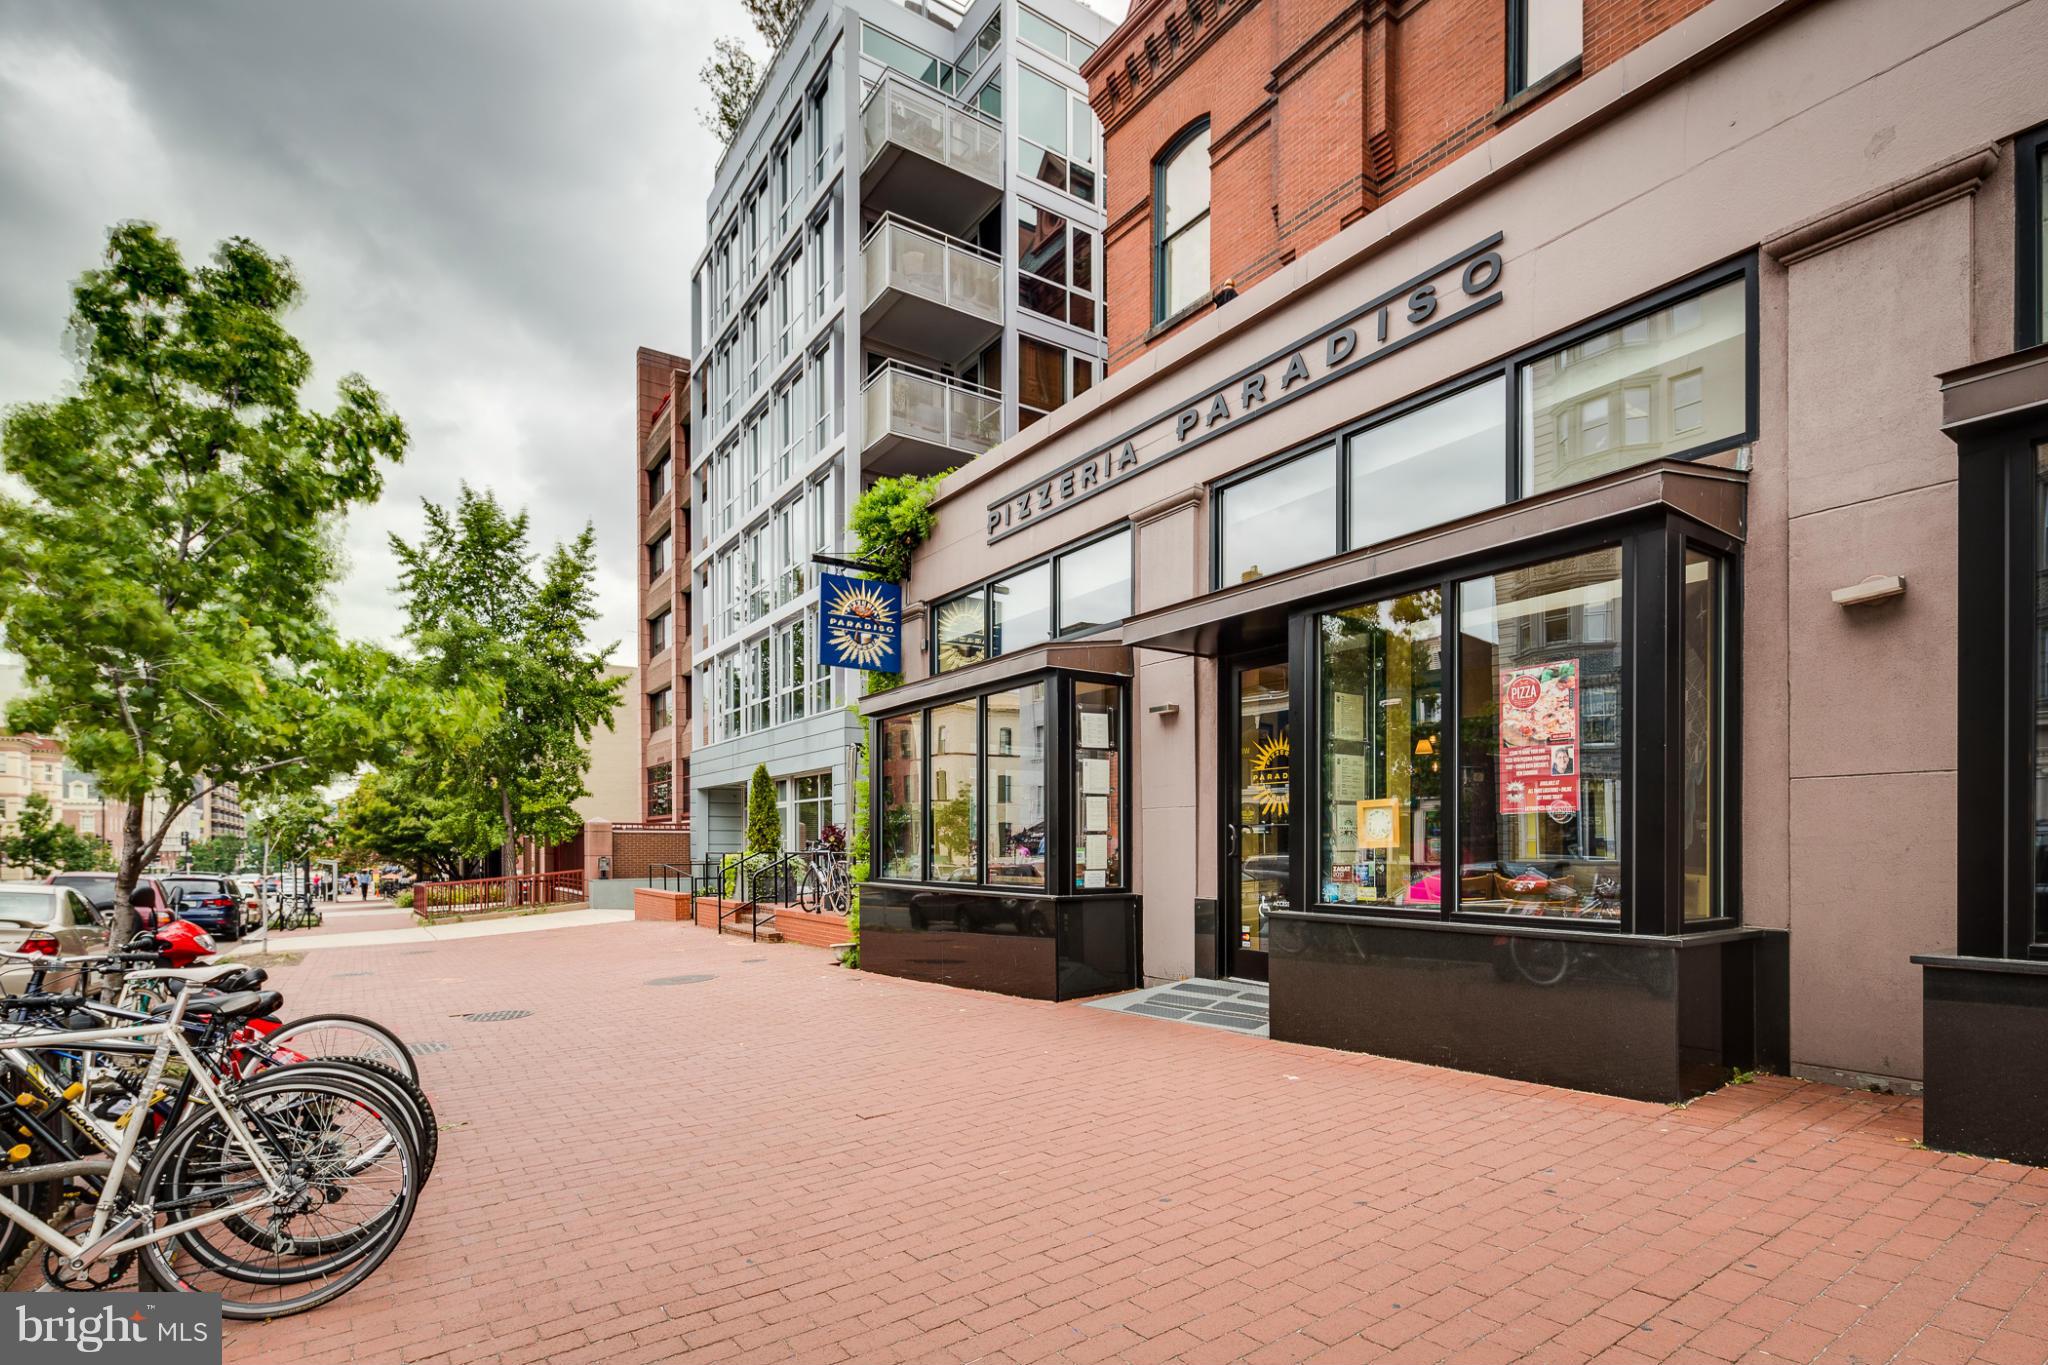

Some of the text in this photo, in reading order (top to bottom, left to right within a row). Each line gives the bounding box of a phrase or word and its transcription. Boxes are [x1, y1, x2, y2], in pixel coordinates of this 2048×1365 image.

[987, 251, 1503, 535] PIZZERIA PARADISO
[829, 617, 895, 633] PARADISO
[1511, 684, 1537, 700] PIZZA
